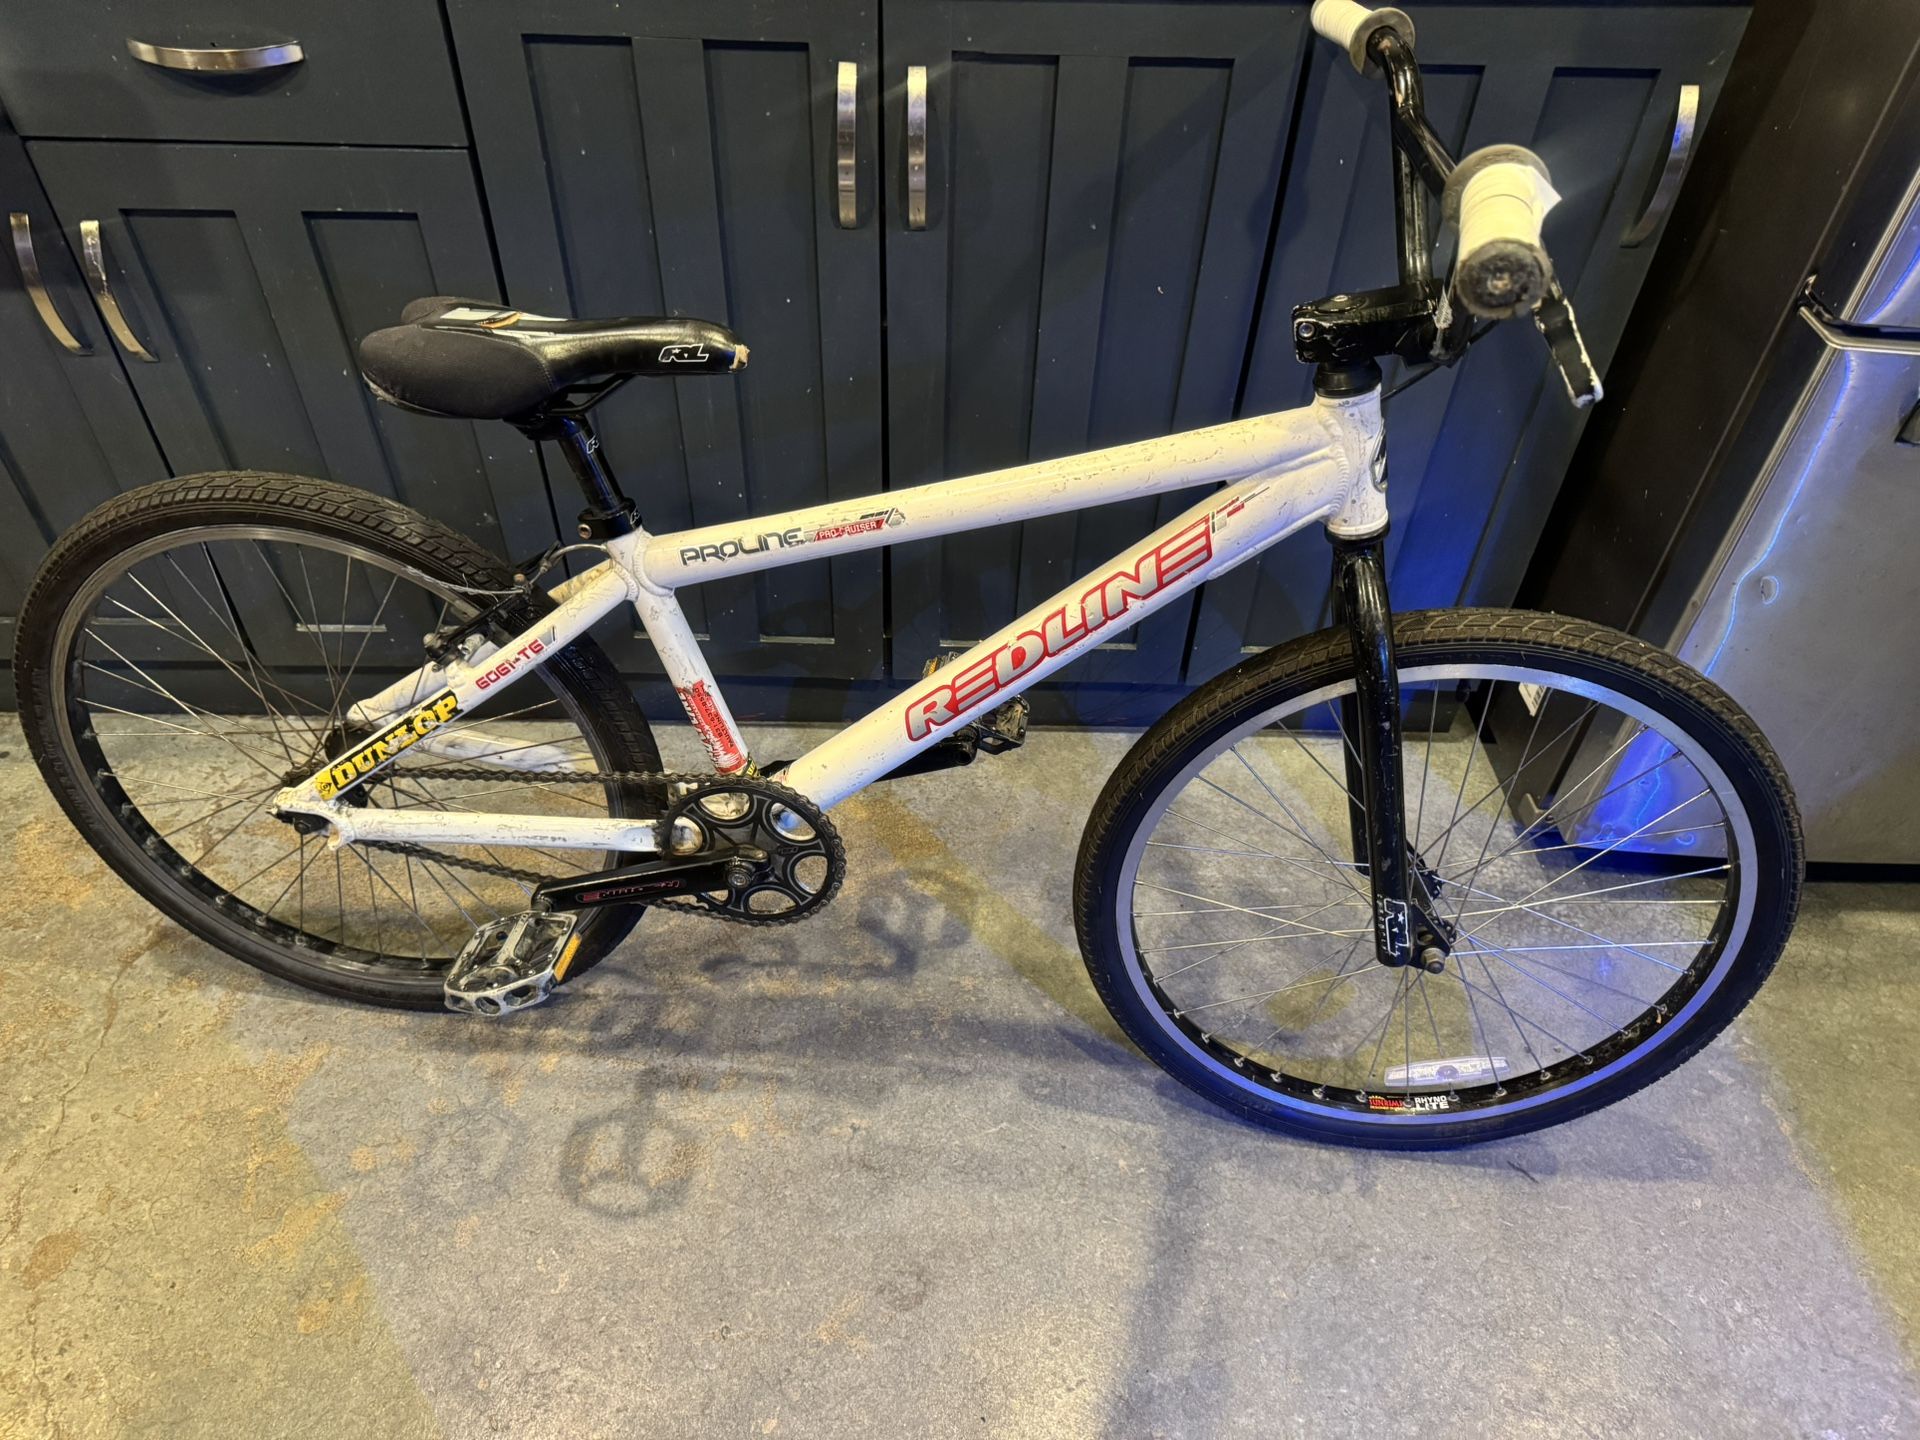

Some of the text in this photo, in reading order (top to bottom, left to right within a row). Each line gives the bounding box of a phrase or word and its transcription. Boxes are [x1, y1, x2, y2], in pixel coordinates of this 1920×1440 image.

[819, 528, 840, 539] PRO
[680, 527, 806, 566] PROLINE
[905, 512, 1213, 742] REDLINE
[330, 691, 460, 790] DUNLOP
[1414, 1095, 1447, 1104] RHYNO
[1415, 1101, 1450, 1111] LITE
